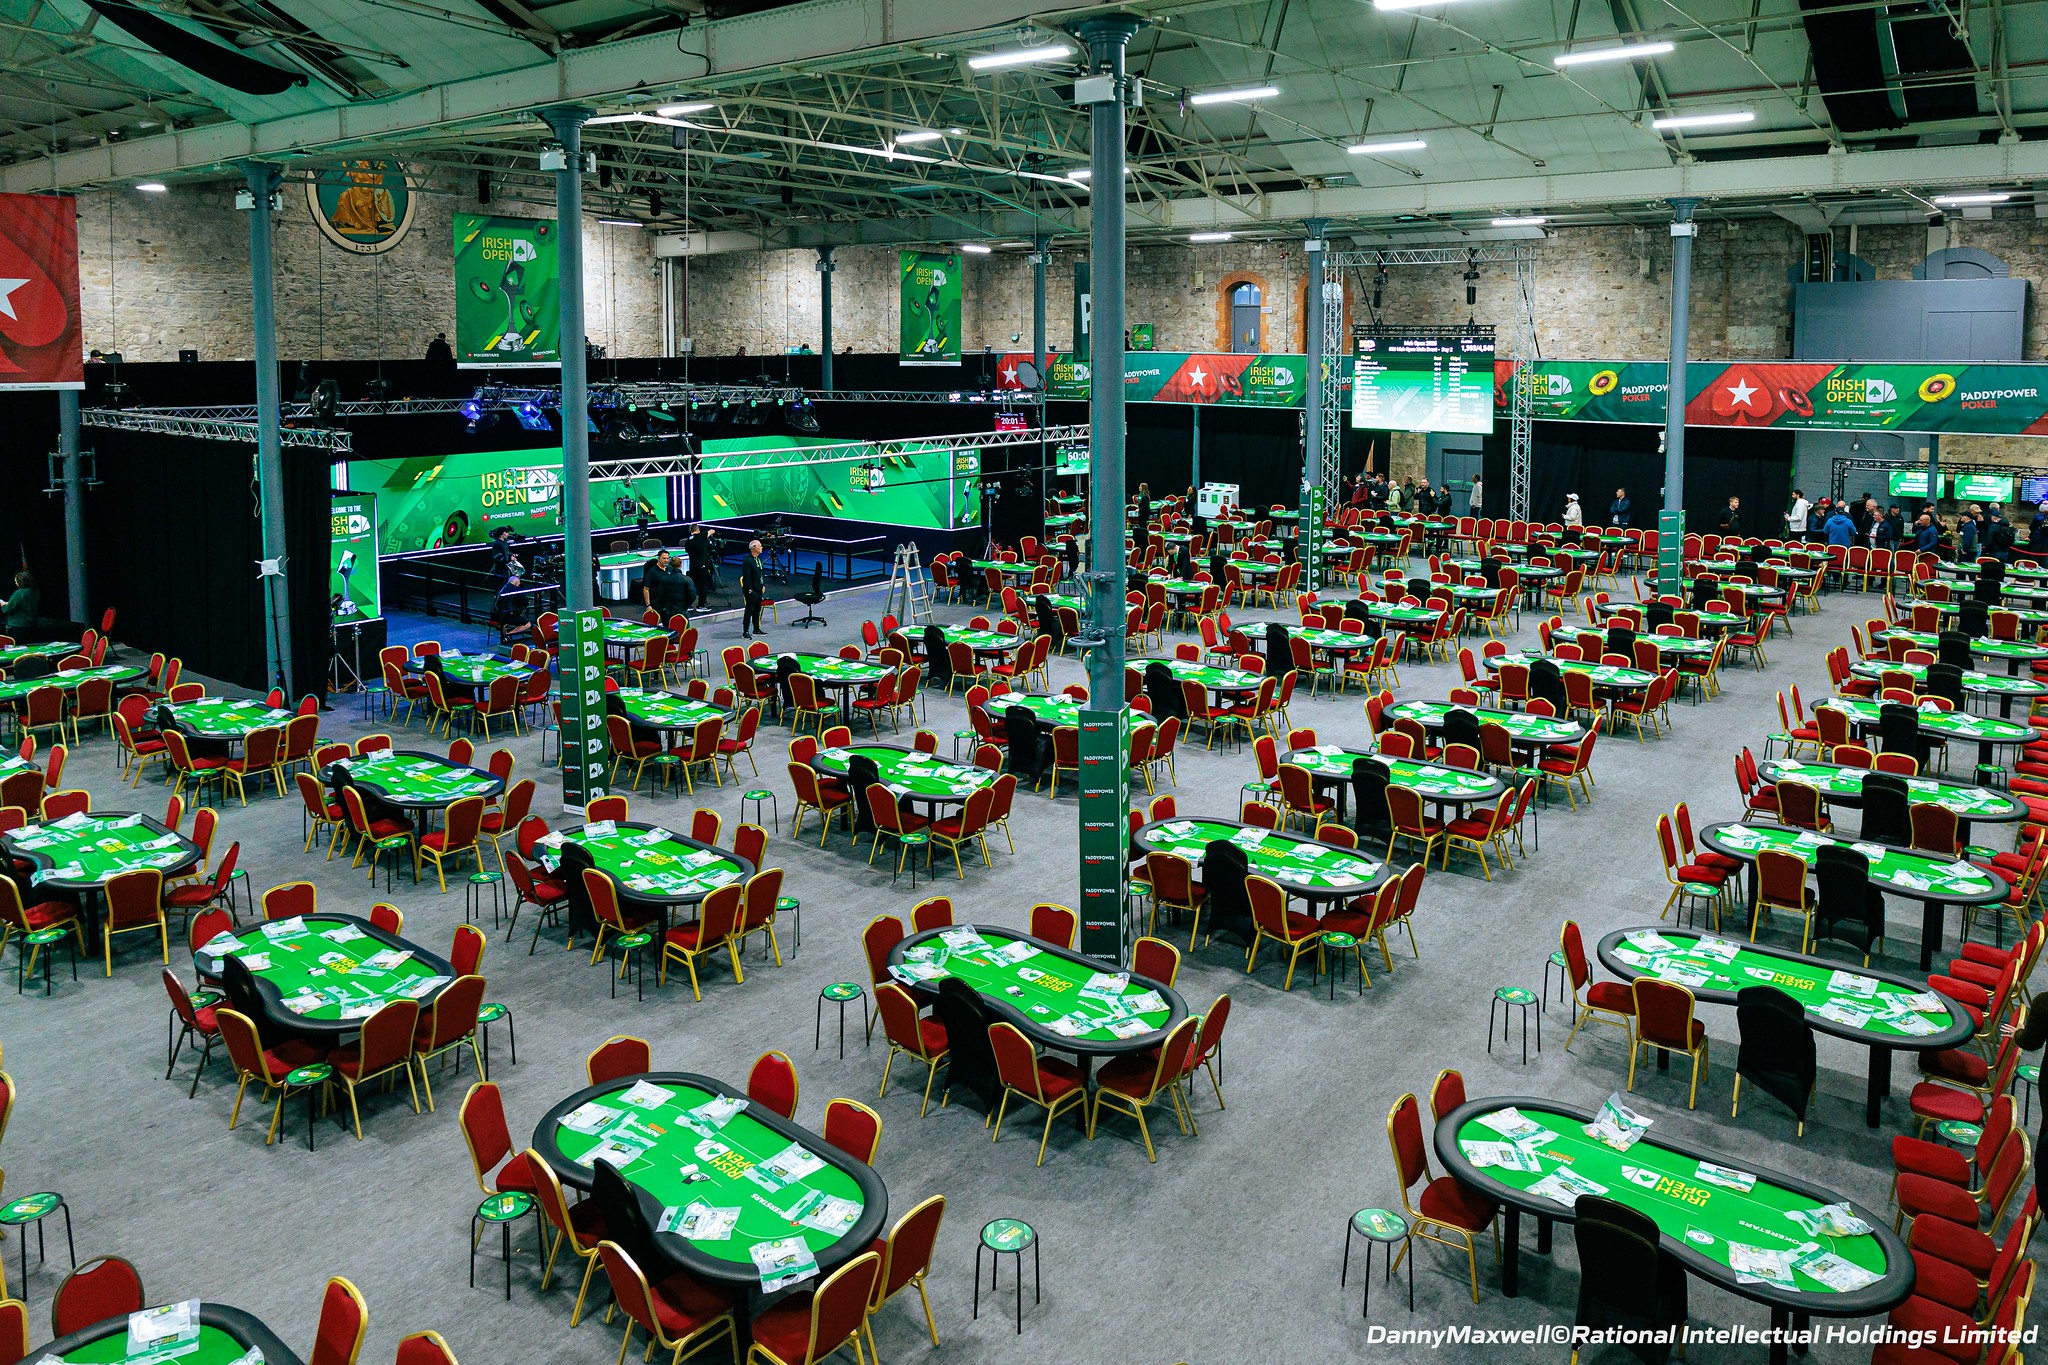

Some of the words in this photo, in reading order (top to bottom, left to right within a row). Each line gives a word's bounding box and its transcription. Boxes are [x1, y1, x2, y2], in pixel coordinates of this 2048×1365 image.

[355, 244, 378, 252] 1731
[482, 237, 513, 250] IRISH
[482, 249, 513, 261] OPEN
[916, 268, 934, 277] IRISH
[916, 277, 934, 286] OPEN
[1053, 363, 1074, 372] IRISH
[1250, 366, 1274, 376] IRISH
[1053, 373, 1074, 381] OPEN
[1124, 369, 1161, 378] ADDYPOWER
[1124, 377, 1140, 385] OKER
[1250, 376, 1274, 386] OPEN
[1827, 379, 1865, 391] IRISH
[1621, 384, 1669, 394] PADDYPOW
[1622, 394, 1651, 402] POKER
[1826, 391, 1865, 403] OPEN
[1961, 388, 2038, 401] PADDYPOWER
[1961, 400, 1997, 410] POKER
[1000, 417, 1018, 425] 20:01
[850, 467, 869, 477] IRISH
[850, 476, 870, 486] OPEN
[481, 488, 527, 508] OPEN
[331, 515, 348, 526] ISH
[490, 511, 525, 520] POKERSTARS
[1034, 978, 1066, 993] IRISH
[1042, 973, 1073, 989] OPEN
[1533, 1150, 1573, 1165] PADDYPO
[708, 1157, 744, 1181] IRISH
[1659, 1176, 1711, 1199] OPEN
[1655, 1183, 1707, 1207] IRISH
[750, 1193, 784, 1216] KERSTARS
